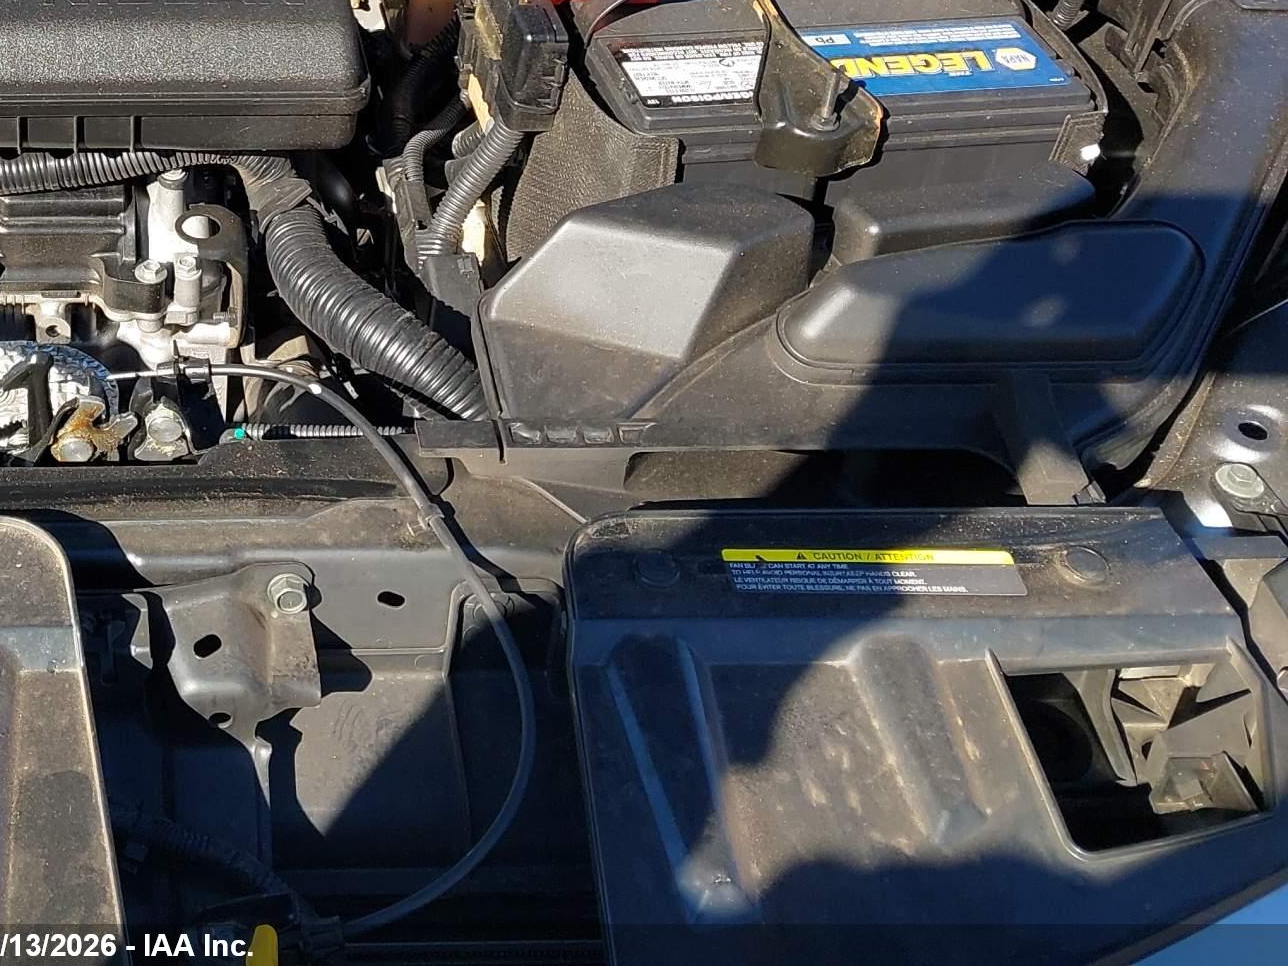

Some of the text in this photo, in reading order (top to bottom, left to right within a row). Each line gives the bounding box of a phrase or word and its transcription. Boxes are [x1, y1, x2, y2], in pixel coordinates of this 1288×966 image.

[829, 49, 994, 79] LEGEND
[1000, 53, 1030, 66] NAPA
[813, 552, 861, 560] CAUTION
[875, 553, 934, 561] ATTENTION
